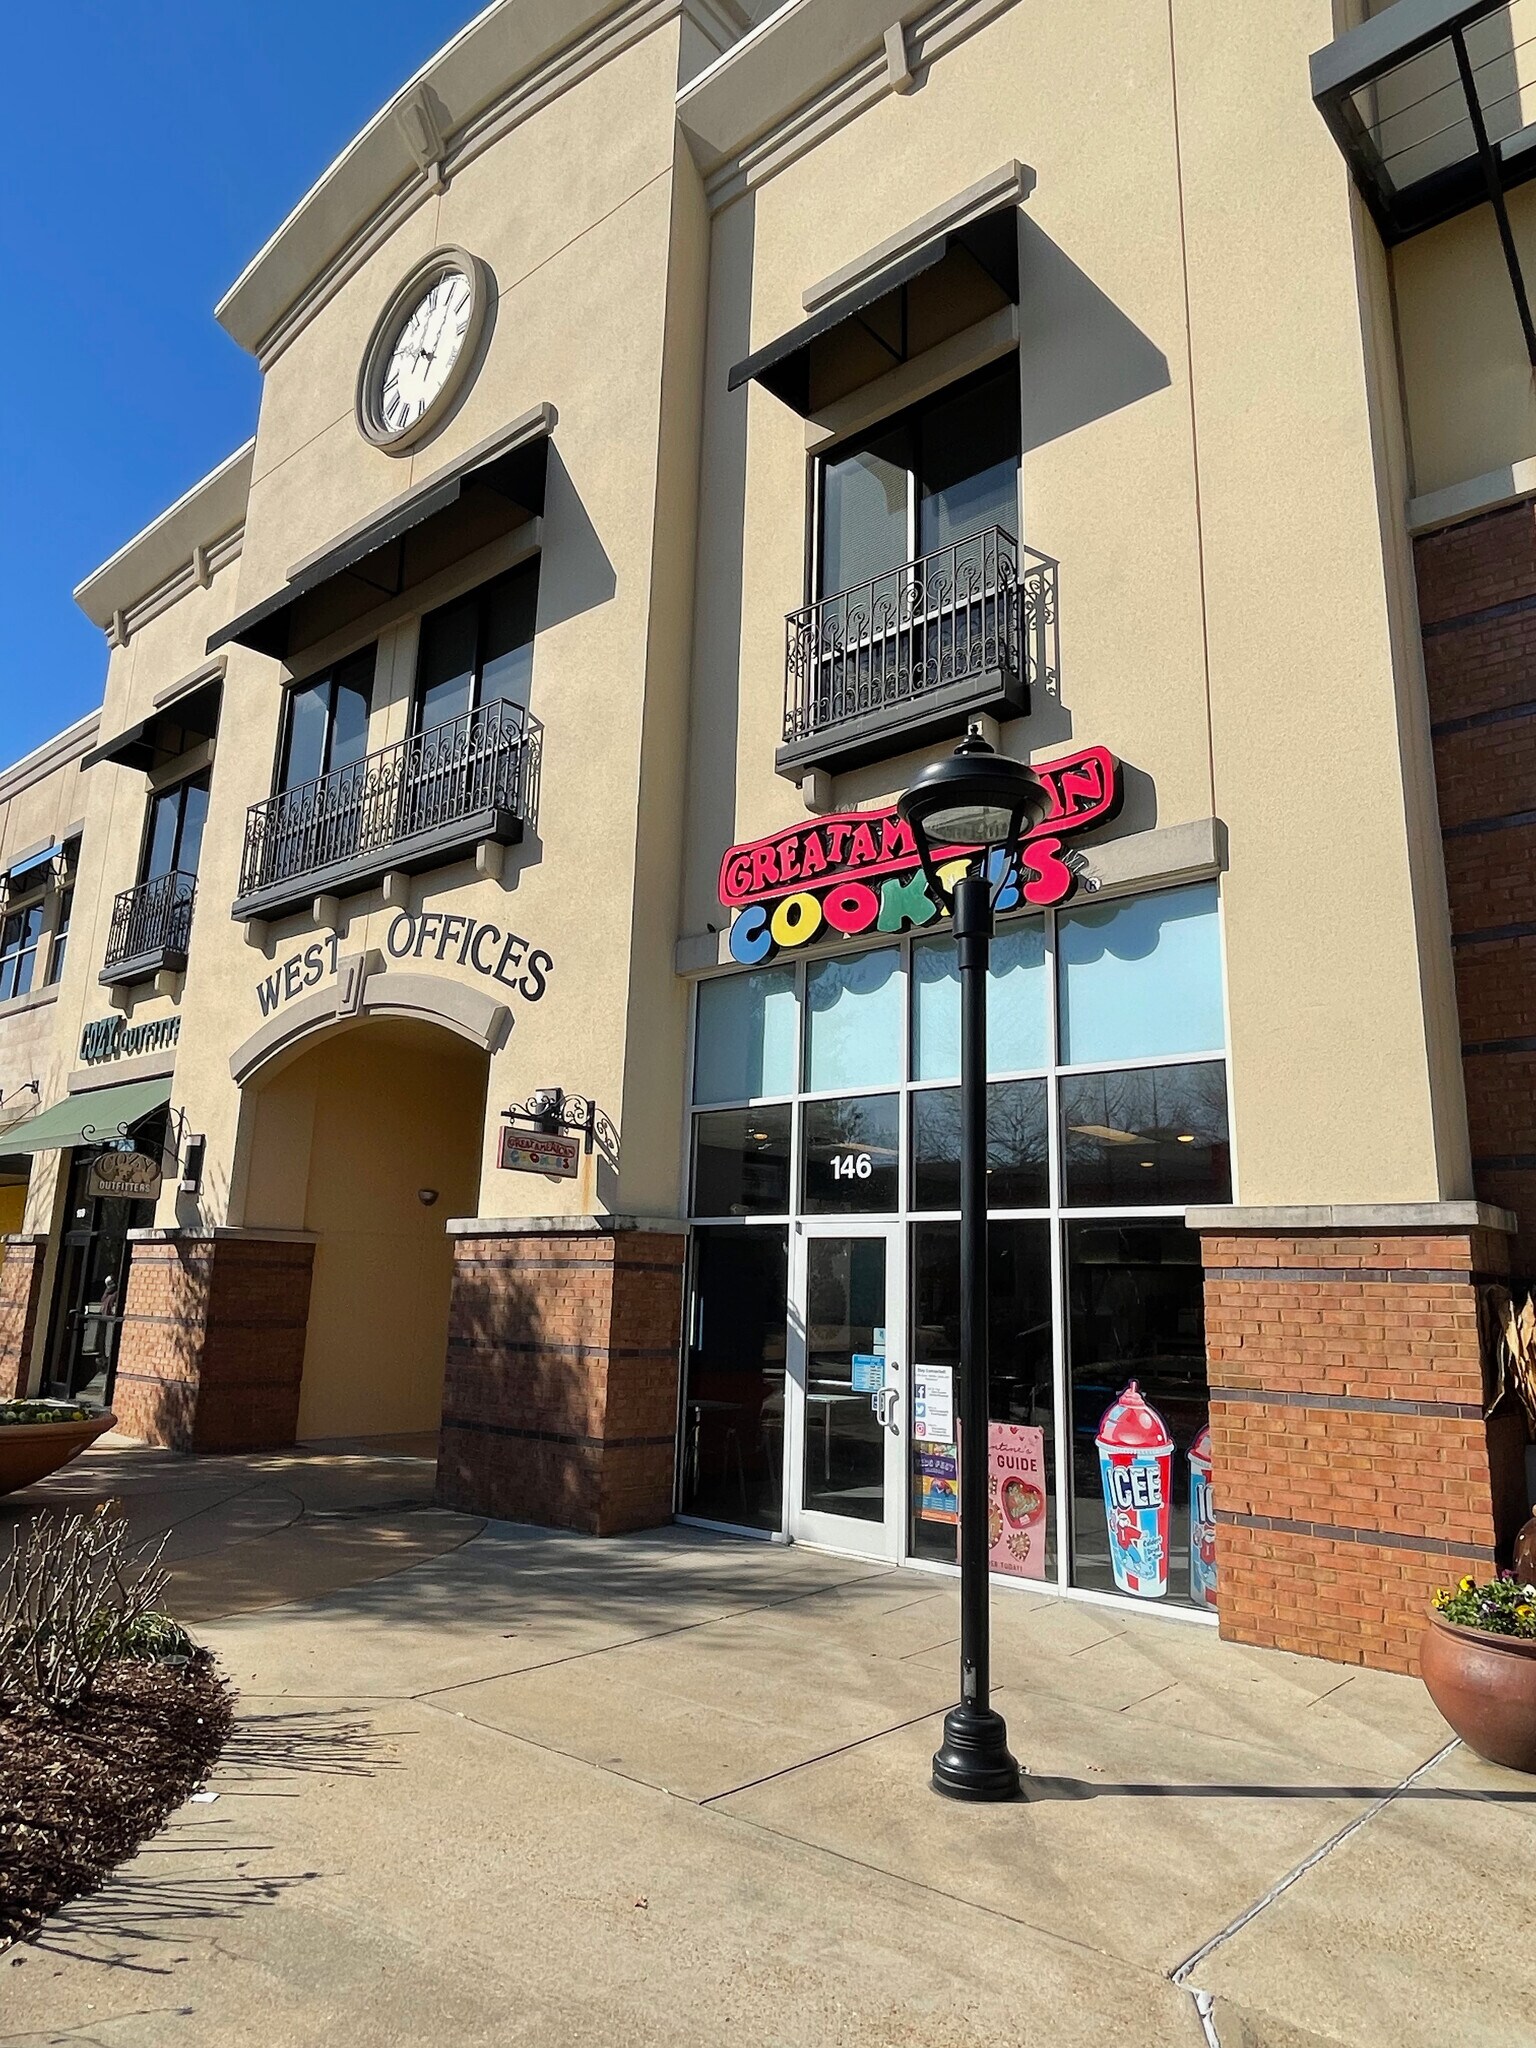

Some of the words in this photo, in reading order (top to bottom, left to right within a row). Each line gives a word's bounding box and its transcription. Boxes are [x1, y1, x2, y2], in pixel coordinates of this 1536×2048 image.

[256, 934, 341, 1018] WEST
[387, 912, 554, 1002] OFFICES
[80, 1014, 120, 1061] COZY
[101, 1152, 155, 1173] COZY
[829, 1152, 873, 1180] 146
[98, 1180, 152, 1193] OUTFITTERS
[997, 1454, 1038, 1472] GUIDE
[1107, 1465, 1163, 1510] ICEE
